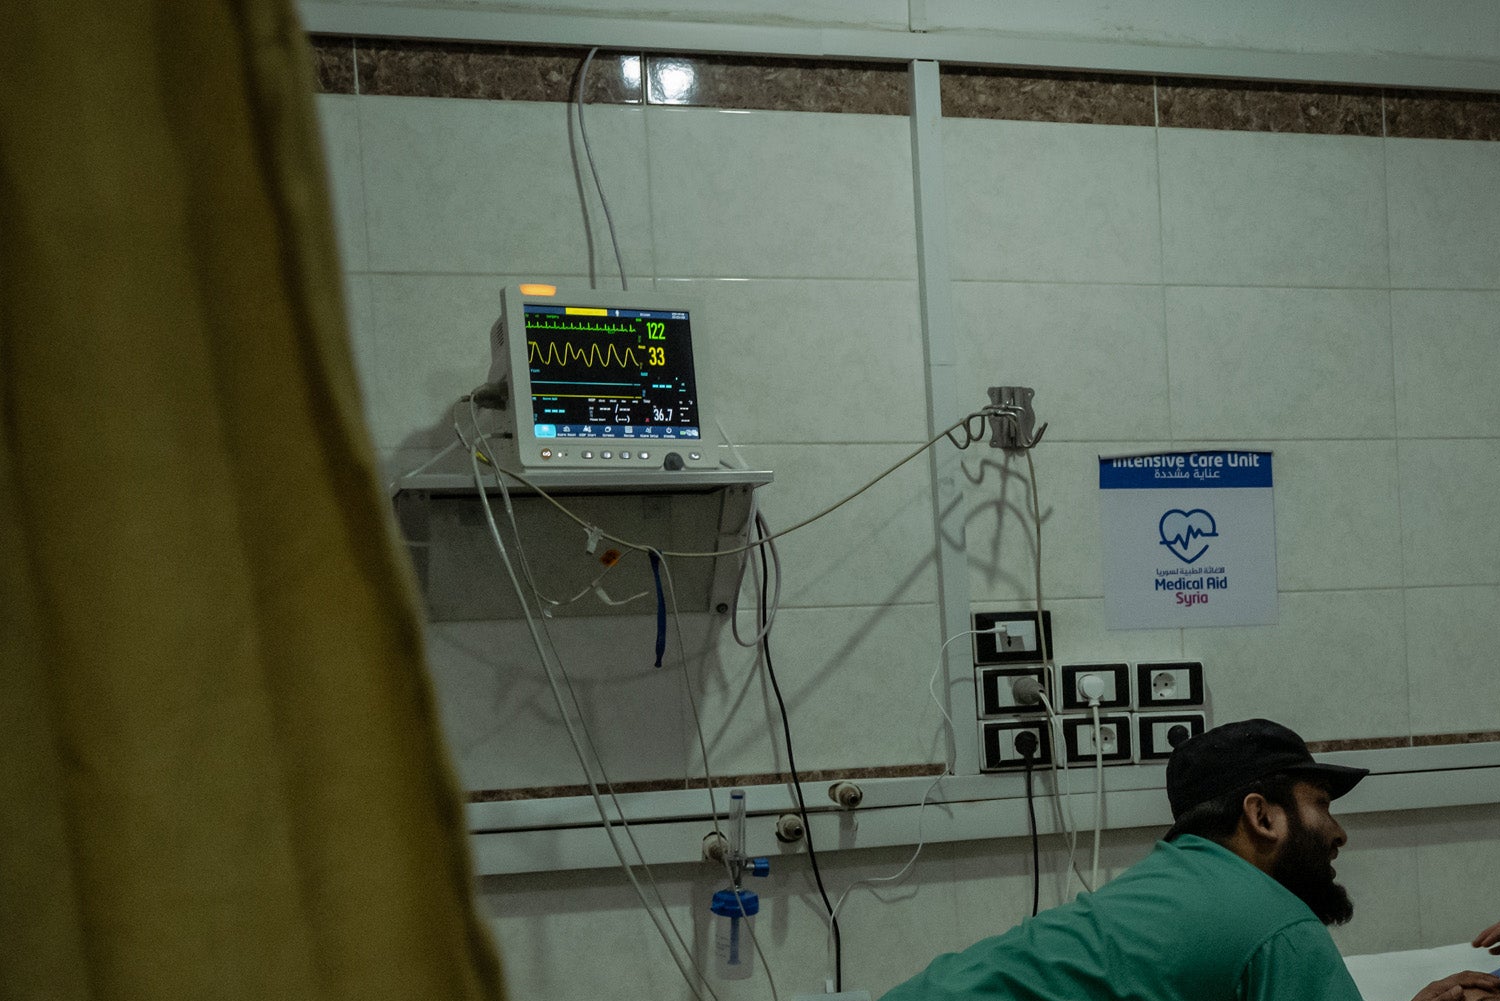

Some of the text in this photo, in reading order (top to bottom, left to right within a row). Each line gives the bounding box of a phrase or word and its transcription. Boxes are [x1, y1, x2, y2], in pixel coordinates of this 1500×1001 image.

[646, 322, 666, 340] 122
[649, 347, 666, 366] 33
[653, 408, 673, 422] 36.7
[1189, 453, 1223, 468] Care
[1227, 453, 1259, 467] Unit
[1154, 467, 1220, 480] عناية مشددة
[1155, 576, 1228, 591] Medical Aid
[1175, 591, 1209, 607] Syria
